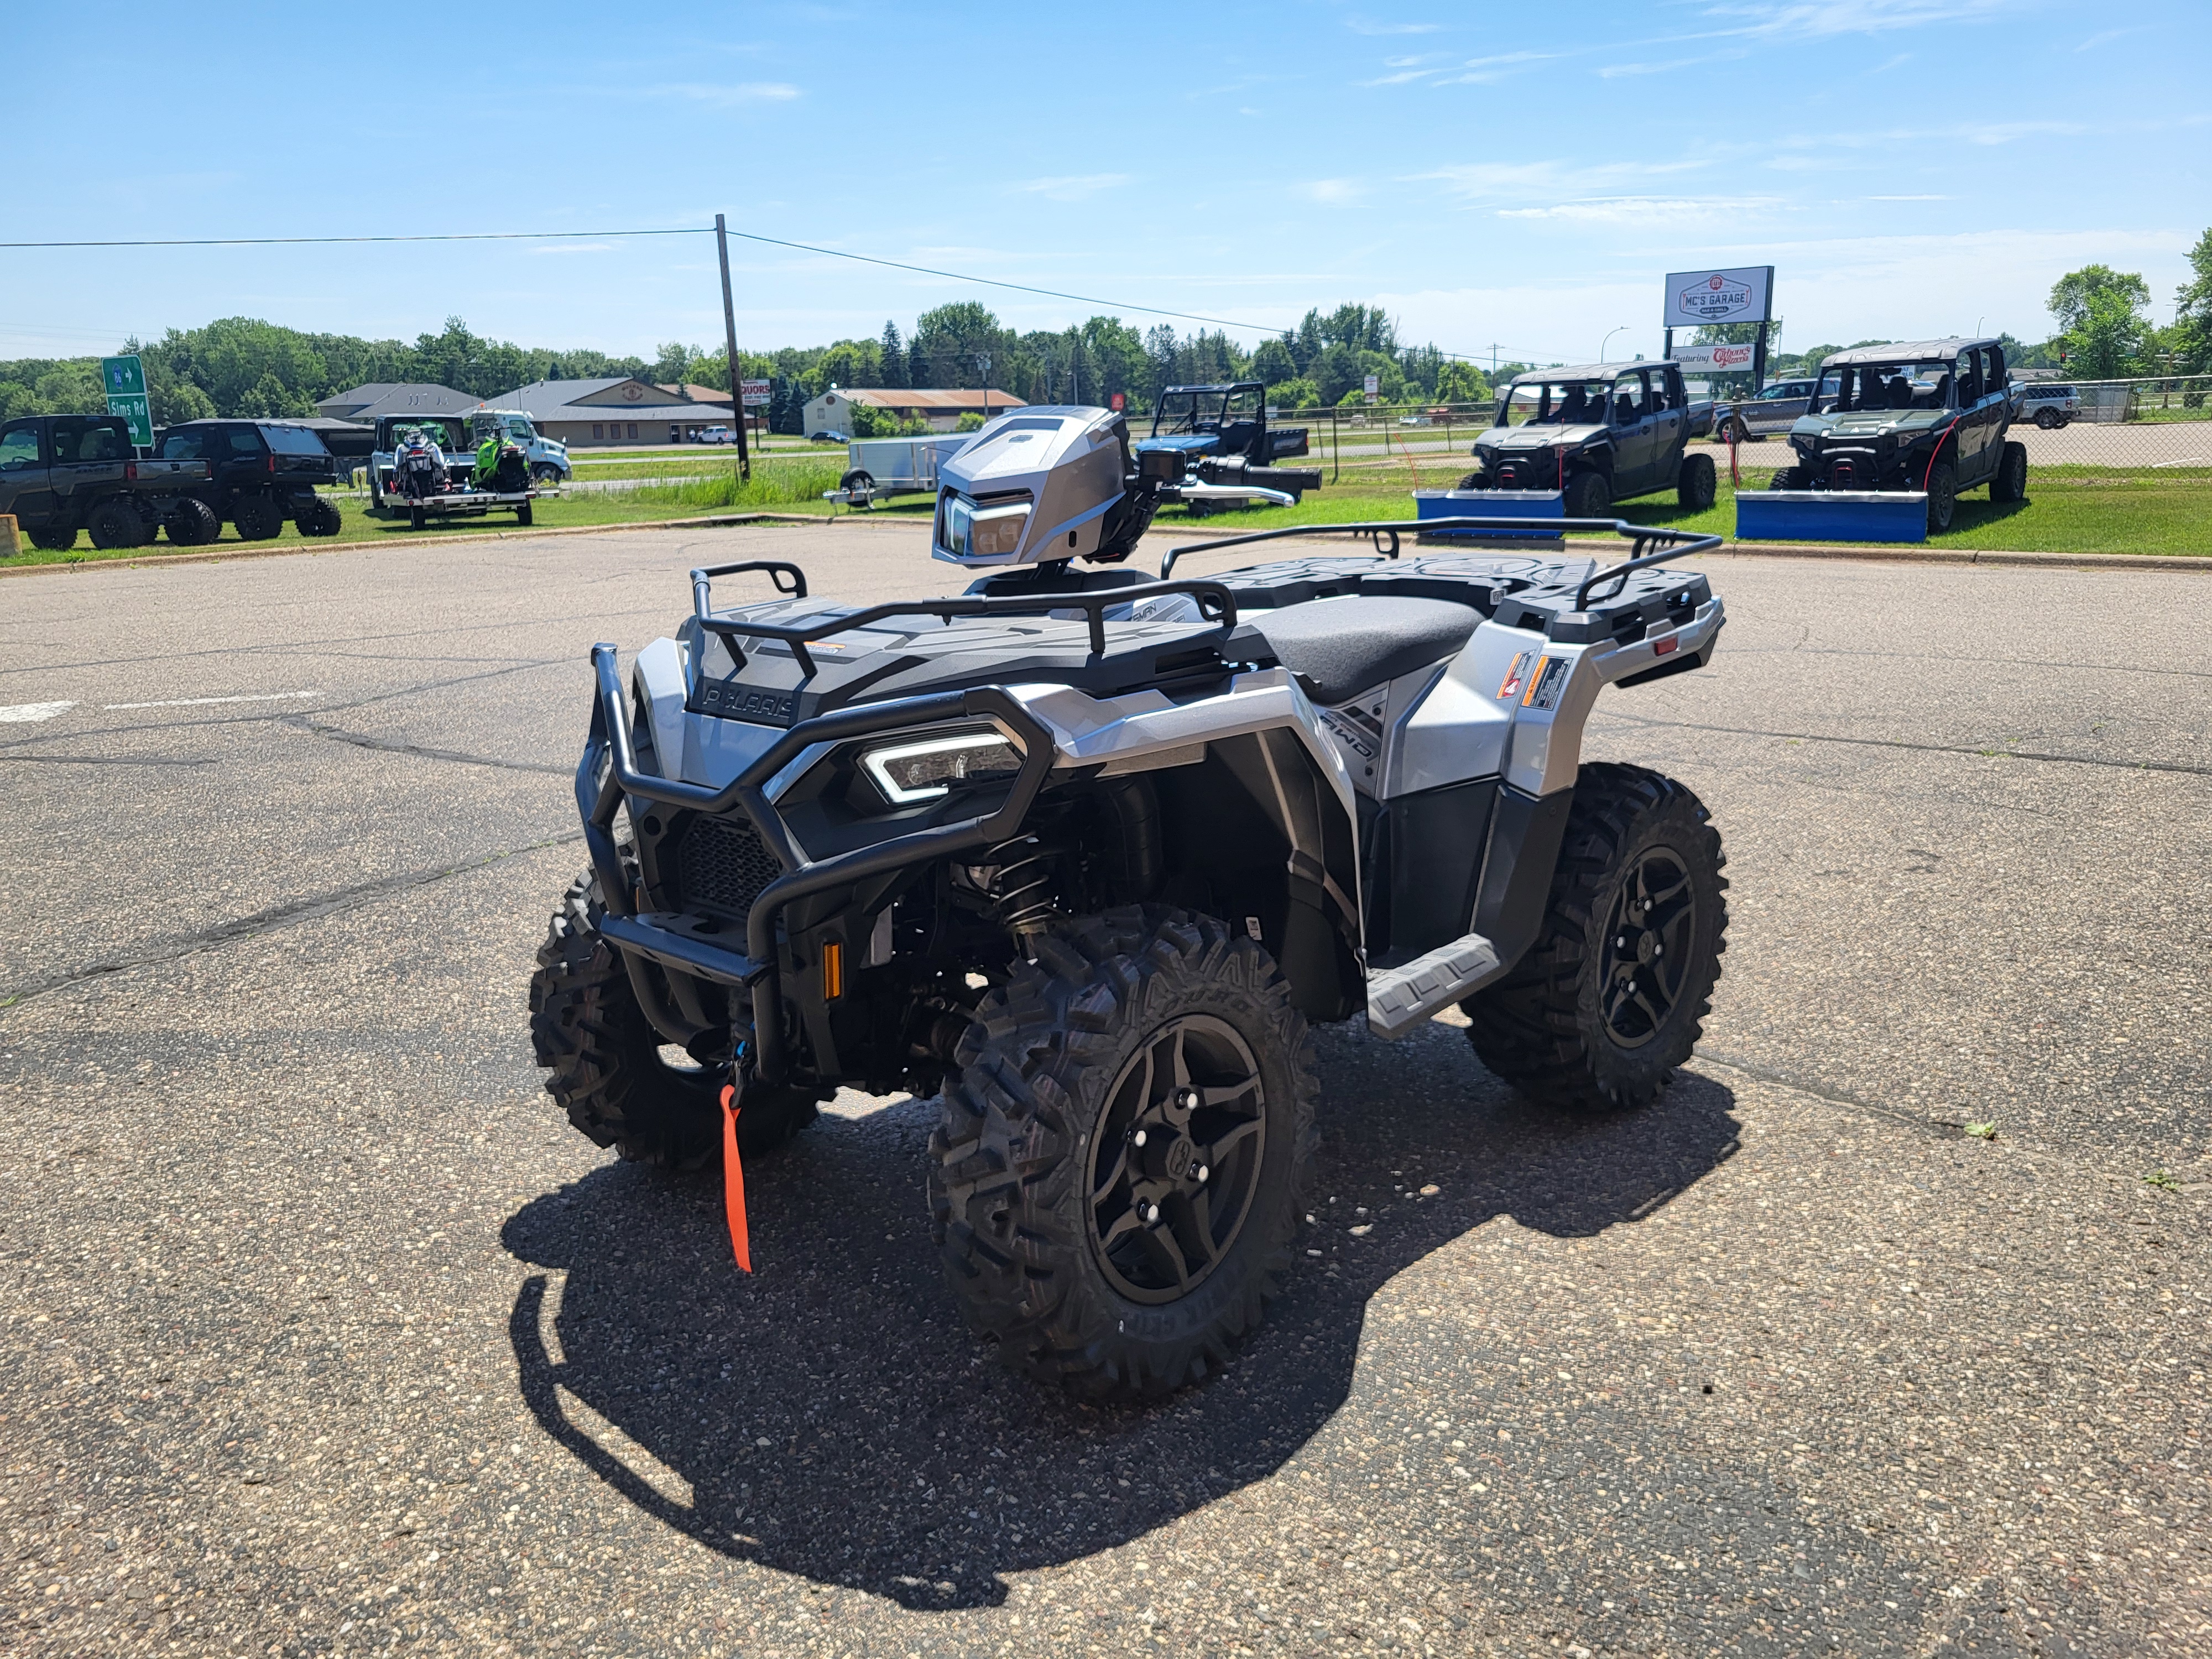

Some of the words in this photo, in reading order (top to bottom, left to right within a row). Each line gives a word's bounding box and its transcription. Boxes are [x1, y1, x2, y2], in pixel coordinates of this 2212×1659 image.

[1685, 295, 1705, 306] MC'S
[1709, 293, 1746, 305] GARAGE
[1671, 353, 1709, 364] Featuring
[742, 385, 770, 395] QUORS
[111, 401, 131, 415] Sims
[134, 400, 145, 415] Rd
[1133, 602, 1157, 622] SMAN
[701, 686, 793, 719] POLARIS
